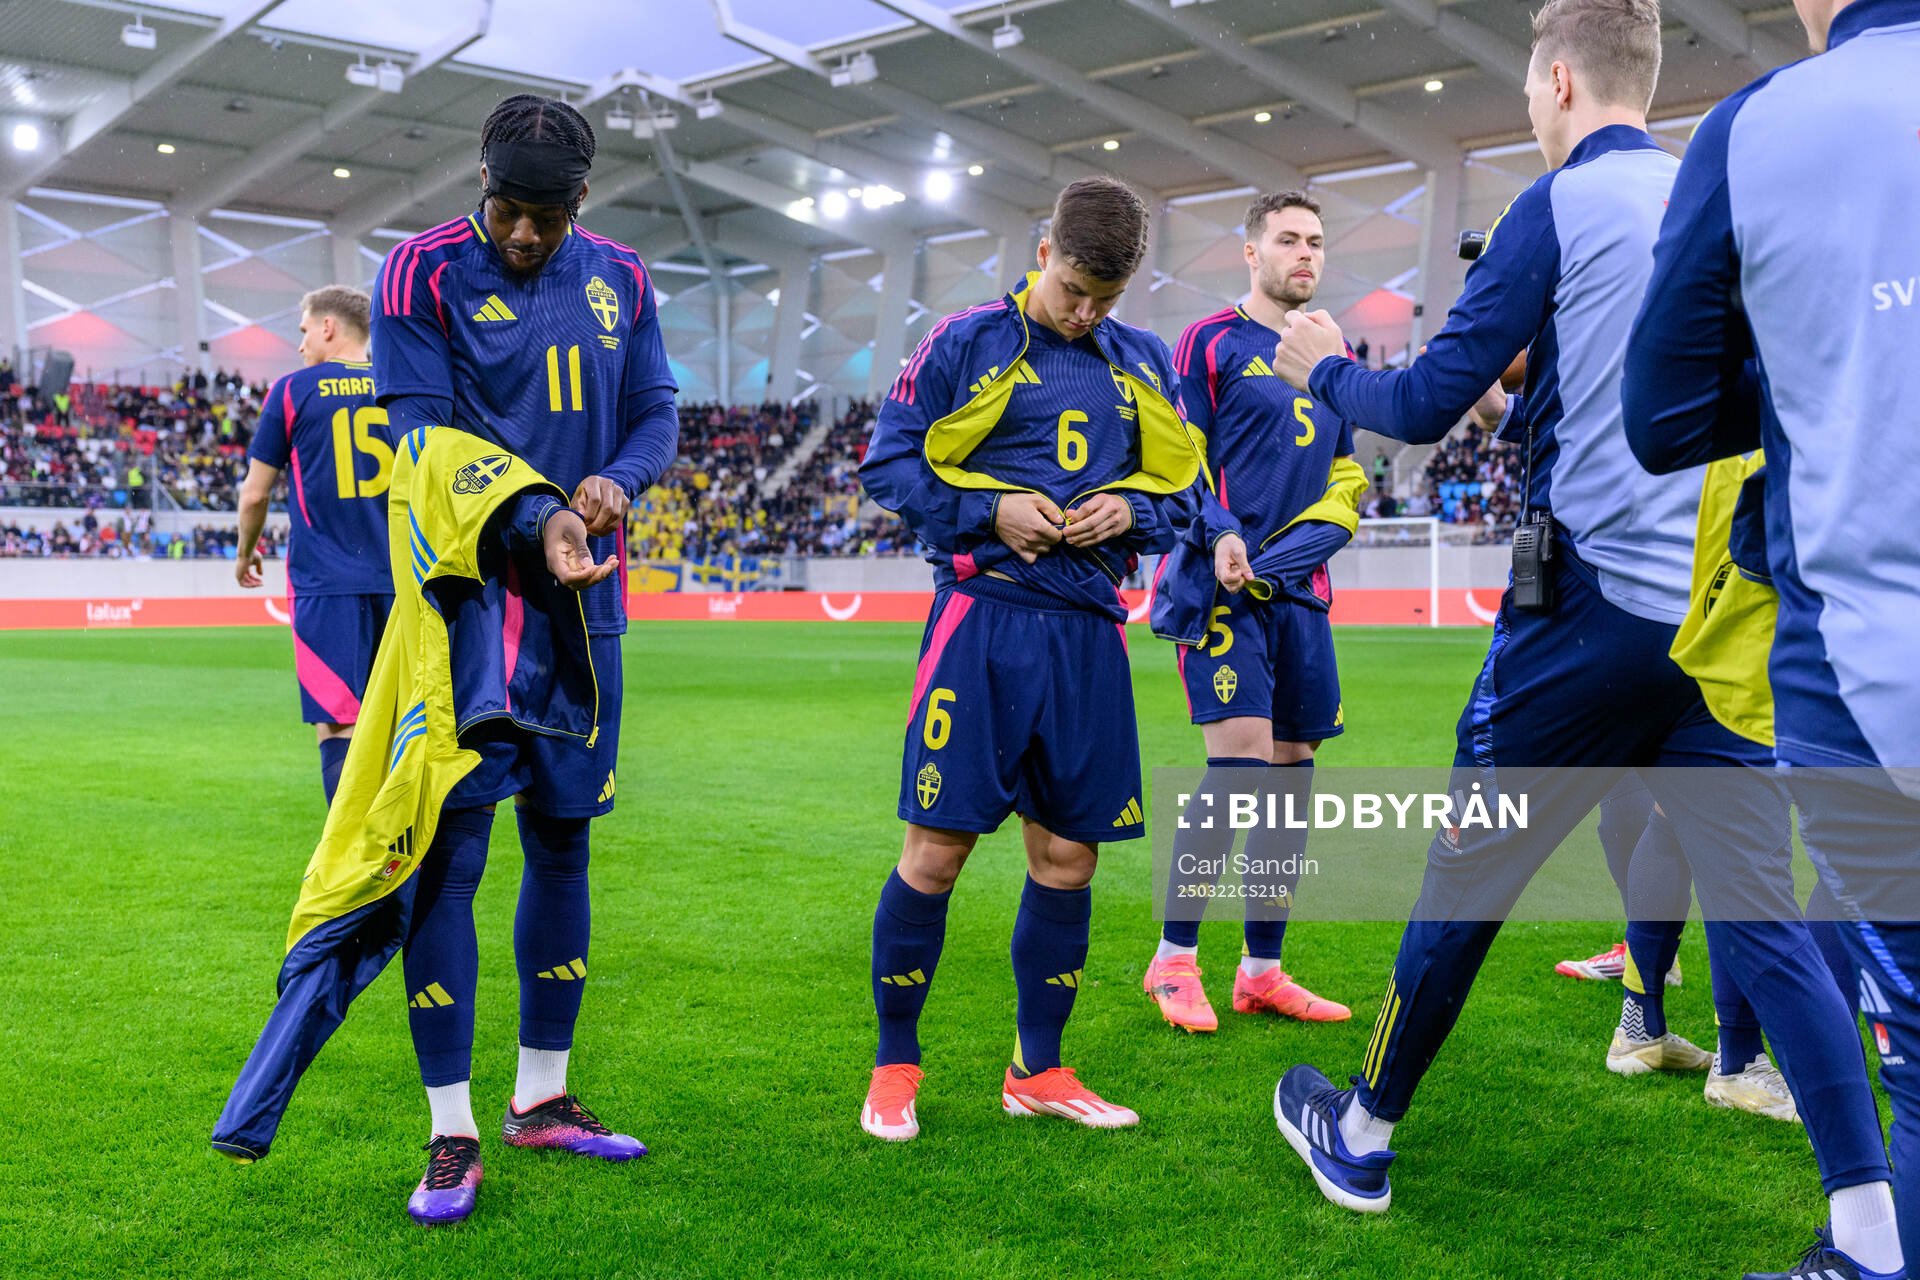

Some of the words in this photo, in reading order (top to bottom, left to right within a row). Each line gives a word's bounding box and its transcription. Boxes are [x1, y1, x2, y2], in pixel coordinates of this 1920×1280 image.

[546, 344, 583, 412] 11
[331, 405, 396, 499] 15
[1057, 409, 1089, 472] 6
[1293, 397, 1316, 447] 5
[1208, 604, 1234, 658] 5
[923, 687, 957, 751] 6
